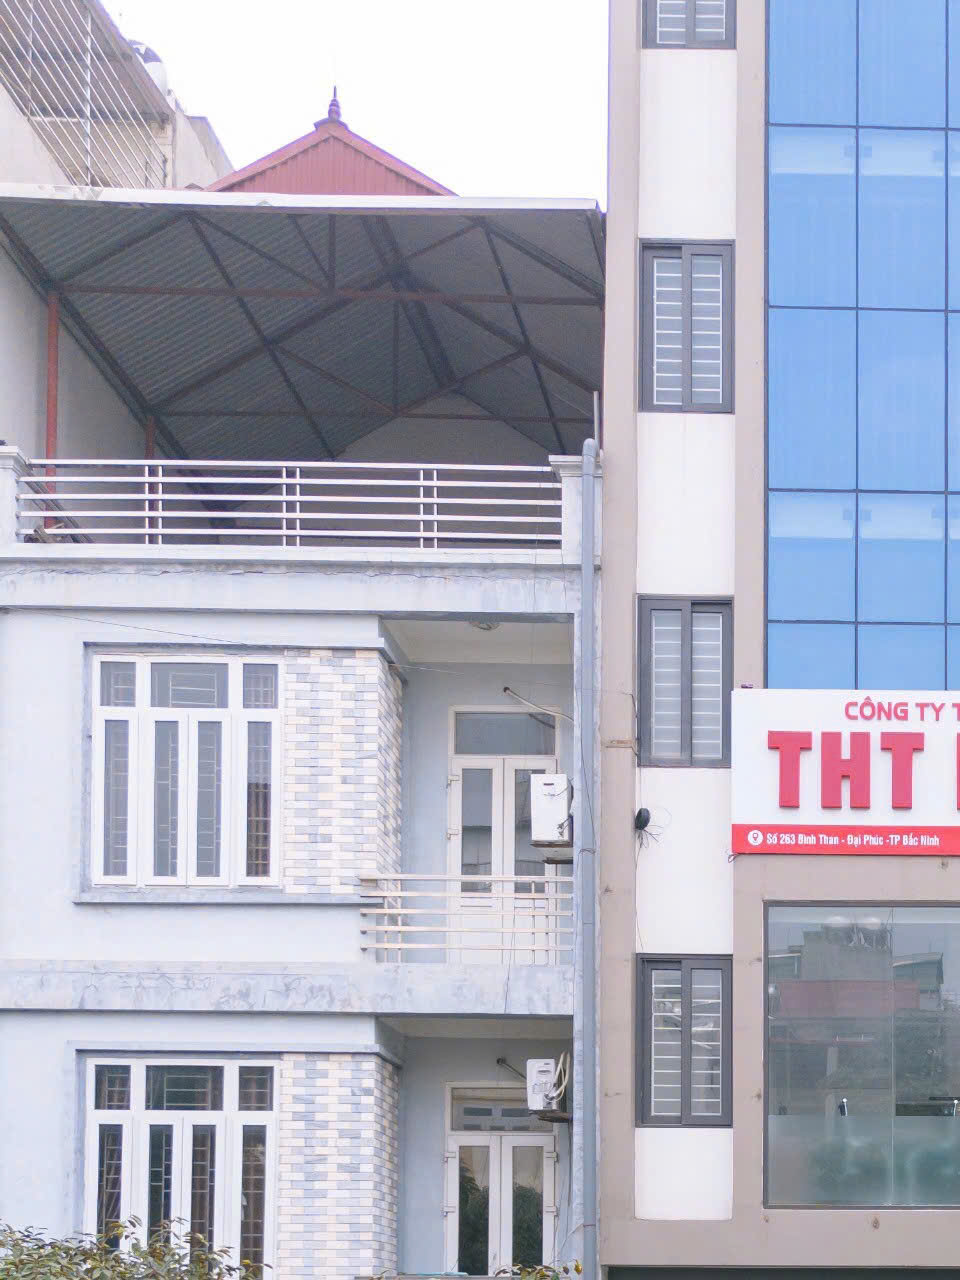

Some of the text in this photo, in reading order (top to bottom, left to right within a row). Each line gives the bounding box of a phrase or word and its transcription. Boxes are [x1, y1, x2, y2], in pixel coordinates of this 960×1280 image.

[844, 695, 909, 721] CÔNG
[915, 702, 945, 721] TY
[767, 730, 925, 810] THT
[779, 834, 796, 845] 263
[818, 834, 839, 846] Than
[920, 834, 939, 846] Ninh
